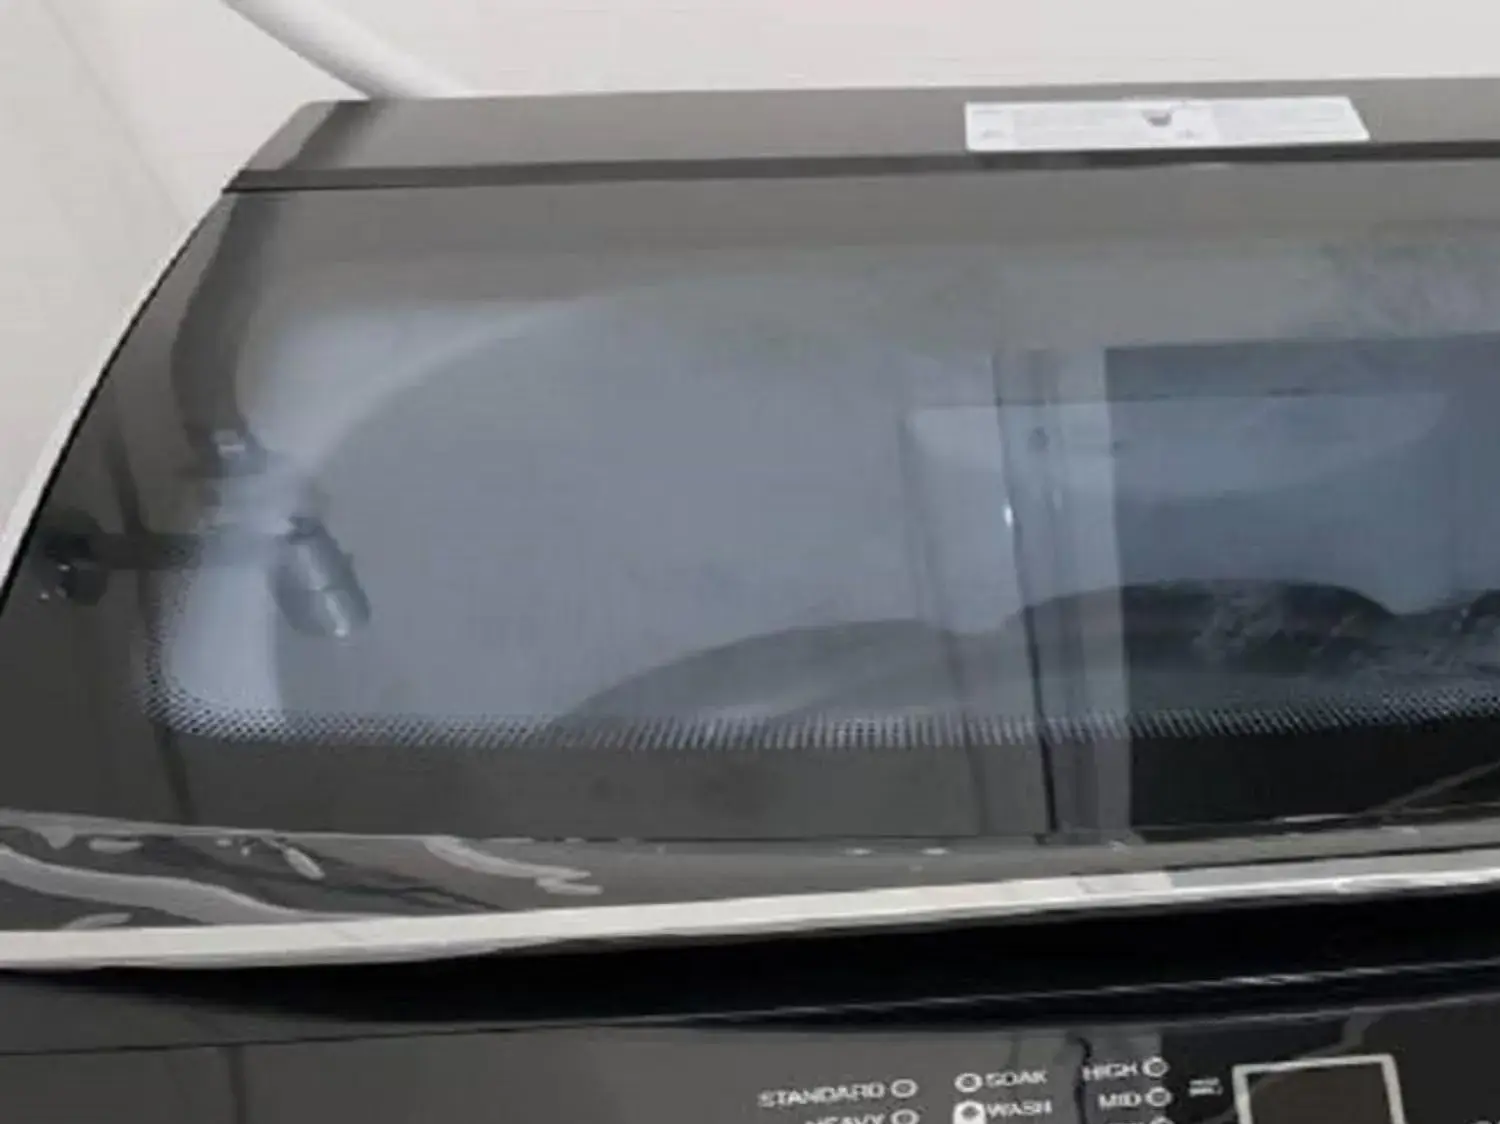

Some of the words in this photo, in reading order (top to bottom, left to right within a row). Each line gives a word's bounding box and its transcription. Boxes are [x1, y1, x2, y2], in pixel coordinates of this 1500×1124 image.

[985, 1070, 1048, 1088] SOAK
[756, 1081, 886, 1107] STANDARD
[1098, 1093, 1143, 1109] MID
[987, 1100, 1052, 1118] WASH
